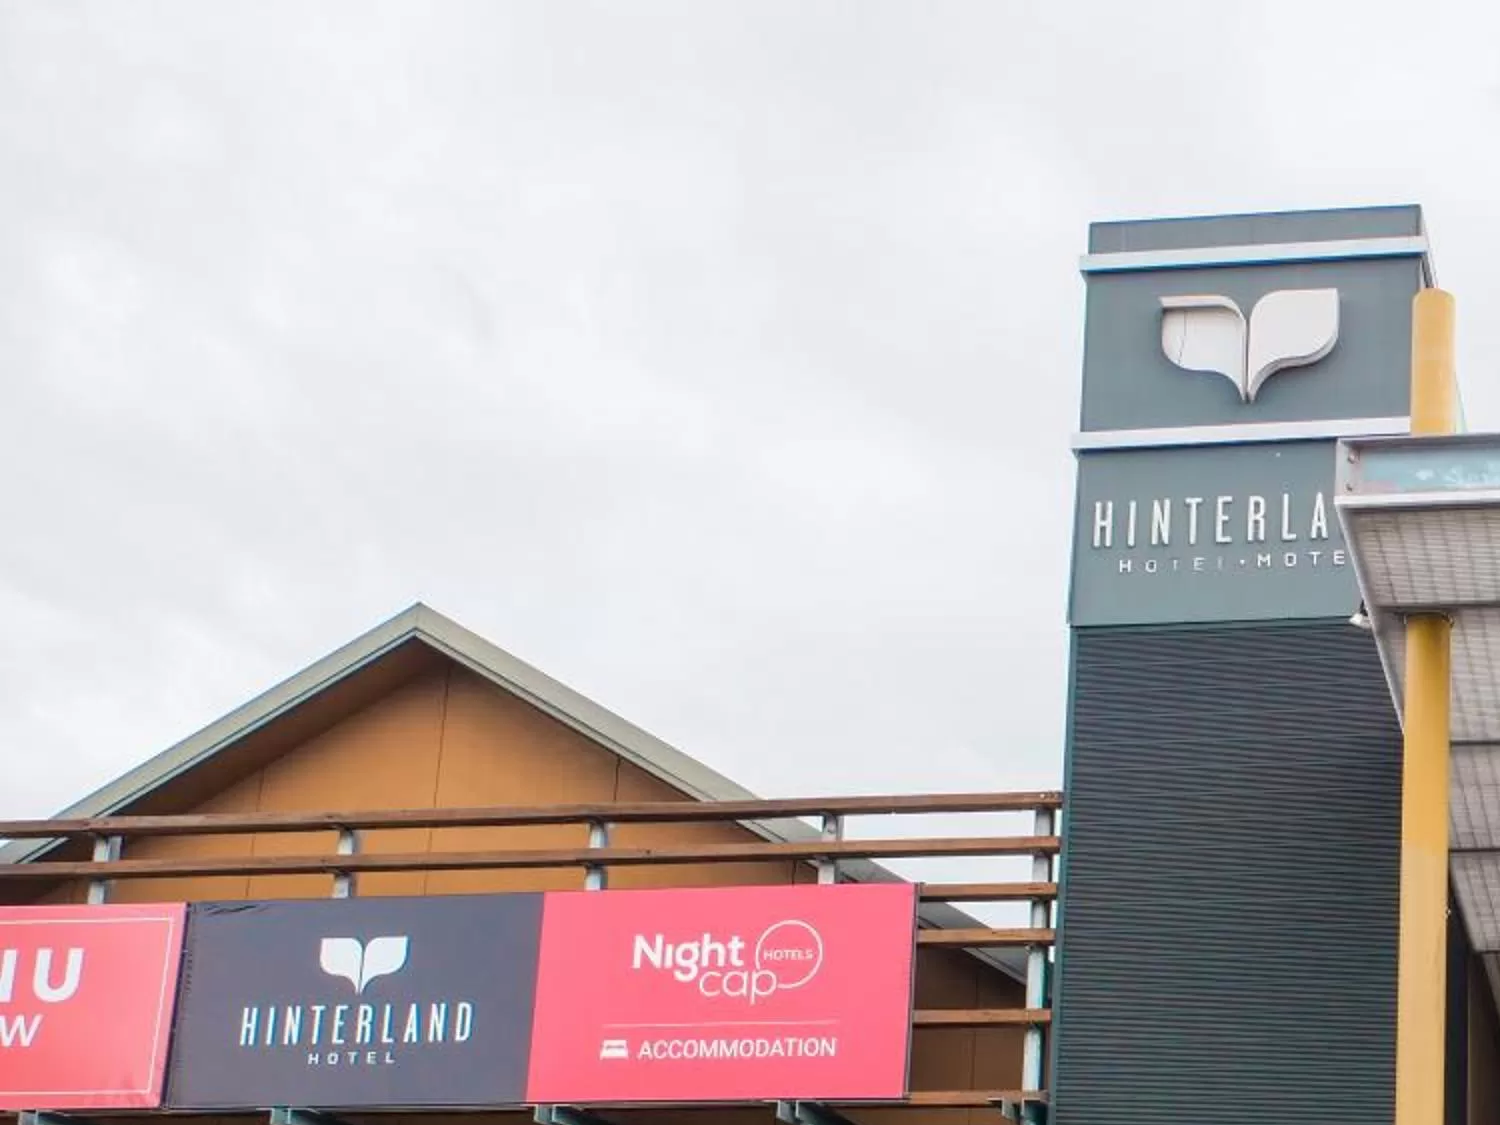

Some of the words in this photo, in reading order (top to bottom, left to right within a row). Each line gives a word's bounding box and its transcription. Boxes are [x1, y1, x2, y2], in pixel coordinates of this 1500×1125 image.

[1092, 491, 1329, 548] HINTERLA
[1256, 549, 1346, 568] MOTE
[631, 932, 745, 982] Night
[763, 947, 814, 961] HOTELS
[699, 968, 778, 1005] cap
[239, 1001, 474, 1047] HINTERLAND
[307, 1050, 396, 1066] HOTEL
[637, 1036, 838, 1060] ACCOMMODATION
